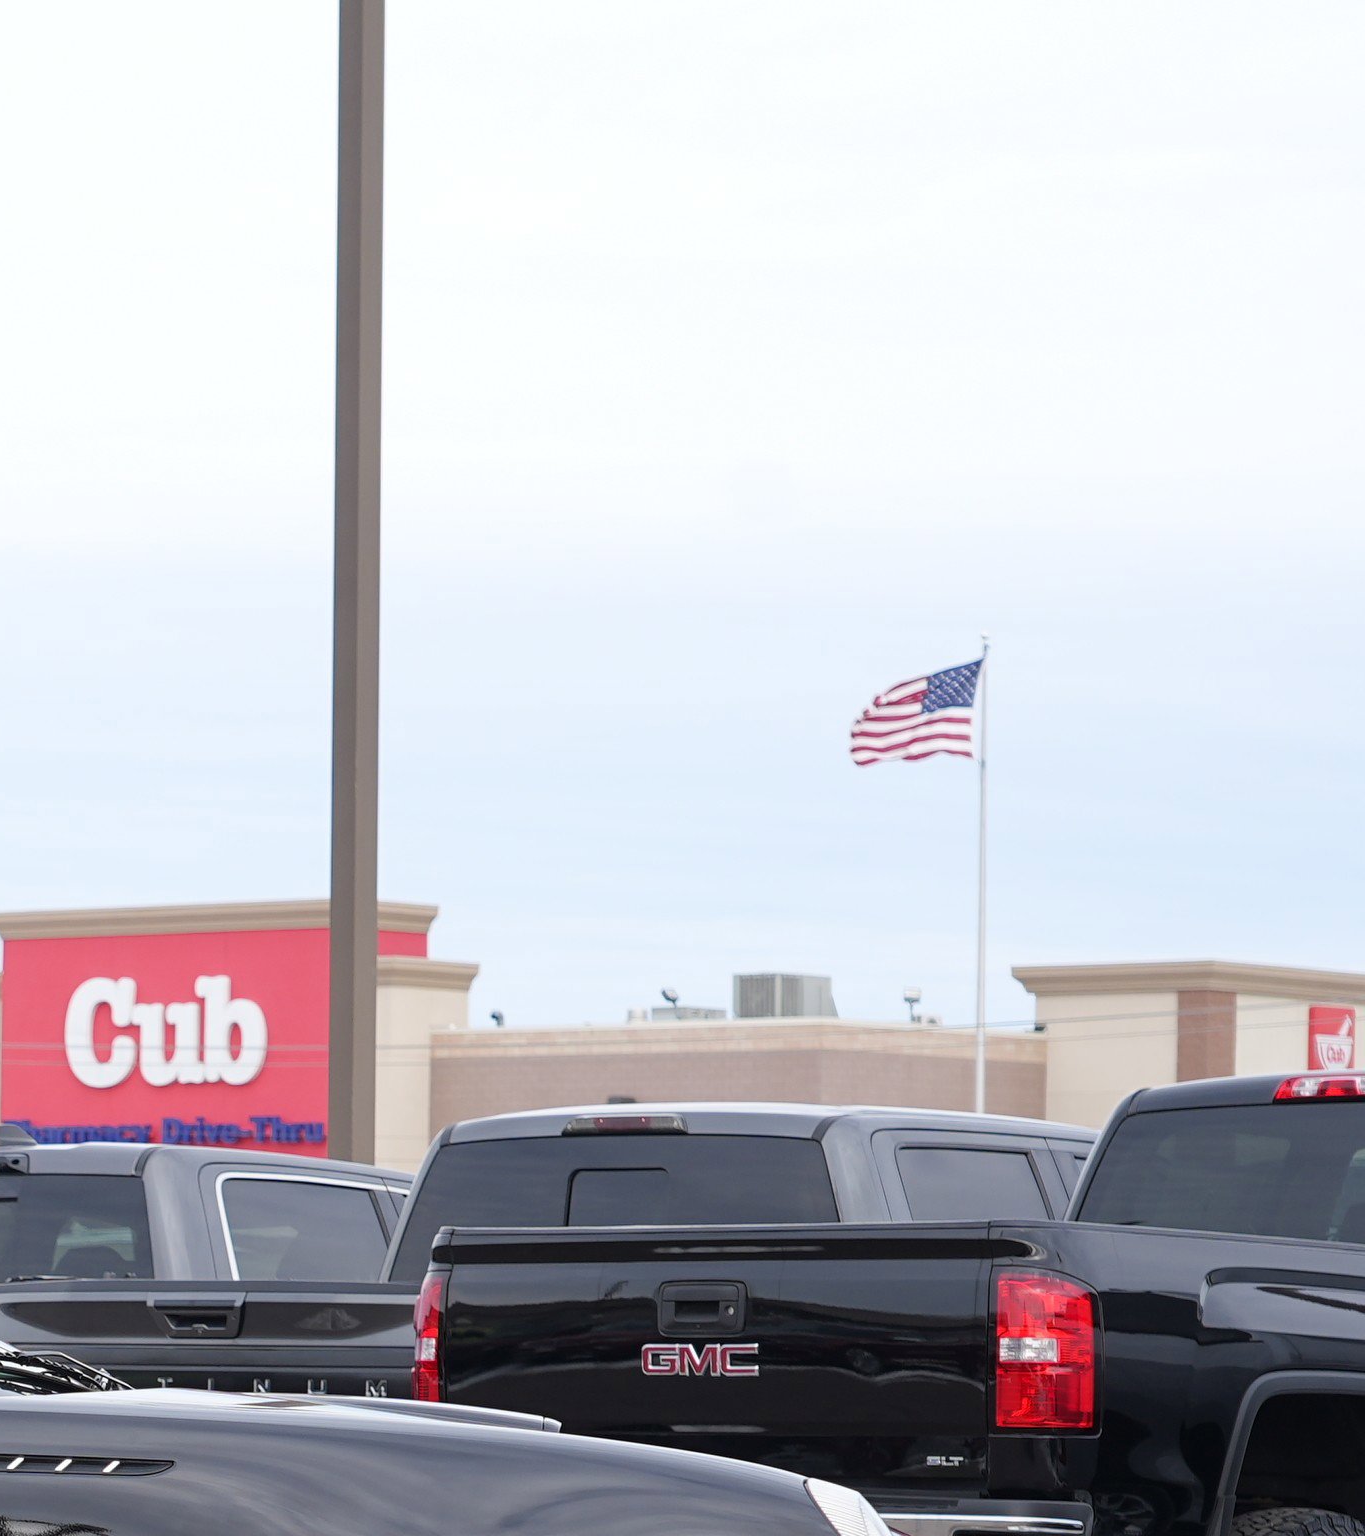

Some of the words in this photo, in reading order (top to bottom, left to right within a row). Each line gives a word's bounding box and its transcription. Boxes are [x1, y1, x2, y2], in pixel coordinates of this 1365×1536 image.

[65, 974, 267, 1088] Cub
[1, 1119, 152, 1144] harmacy
[162, 1116, 326, 1144] Drive-Thru
[641, 1343, 759, 1377] GMC
[926, 1455, 964, 1467] SLT
